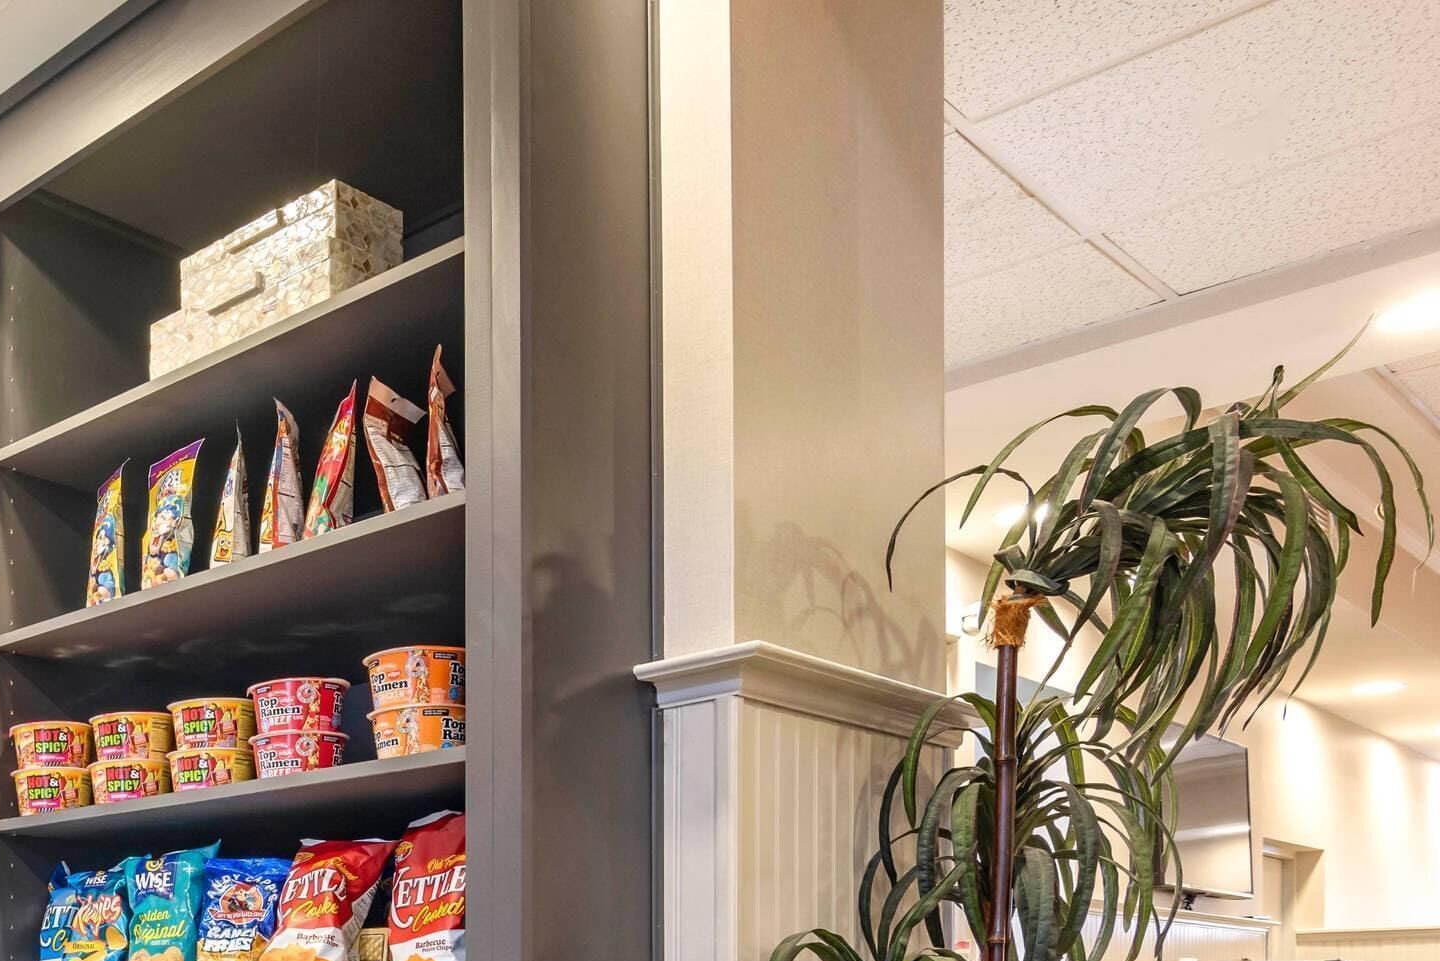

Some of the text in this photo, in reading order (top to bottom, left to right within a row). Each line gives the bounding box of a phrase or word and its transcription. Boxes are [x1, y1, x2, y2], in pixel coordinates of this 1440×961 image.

[259, 698, 277, 708] Top
[182, 706, 205, 721] HOT
[261, 706, 300, 718] Ramen
[183, 720, 216, 734] SPICY
[269, 715, 292, 726] BEEF
[98, 721, 118, 734] HOT
[34, 728, 59, 742] HOT
[100, 733, 127, 747] SPICY
[35, 741, 68, 753] SPICY
[259, 750, 277, 761] Top
[177, 755, 199, 771] HOT
[260, 758, 299, 771] Ramen
[106, 765, 131, 780] HOT
[179, 769, 208, 784] SPICY
[27, 775, 50, 788] HOT
[107, 779, 140, 793] SPICY
[28, 788, 60, 800] SPICY
[85, 874, 109, 886] WISE
[135, 871, 174, 892] WISE
